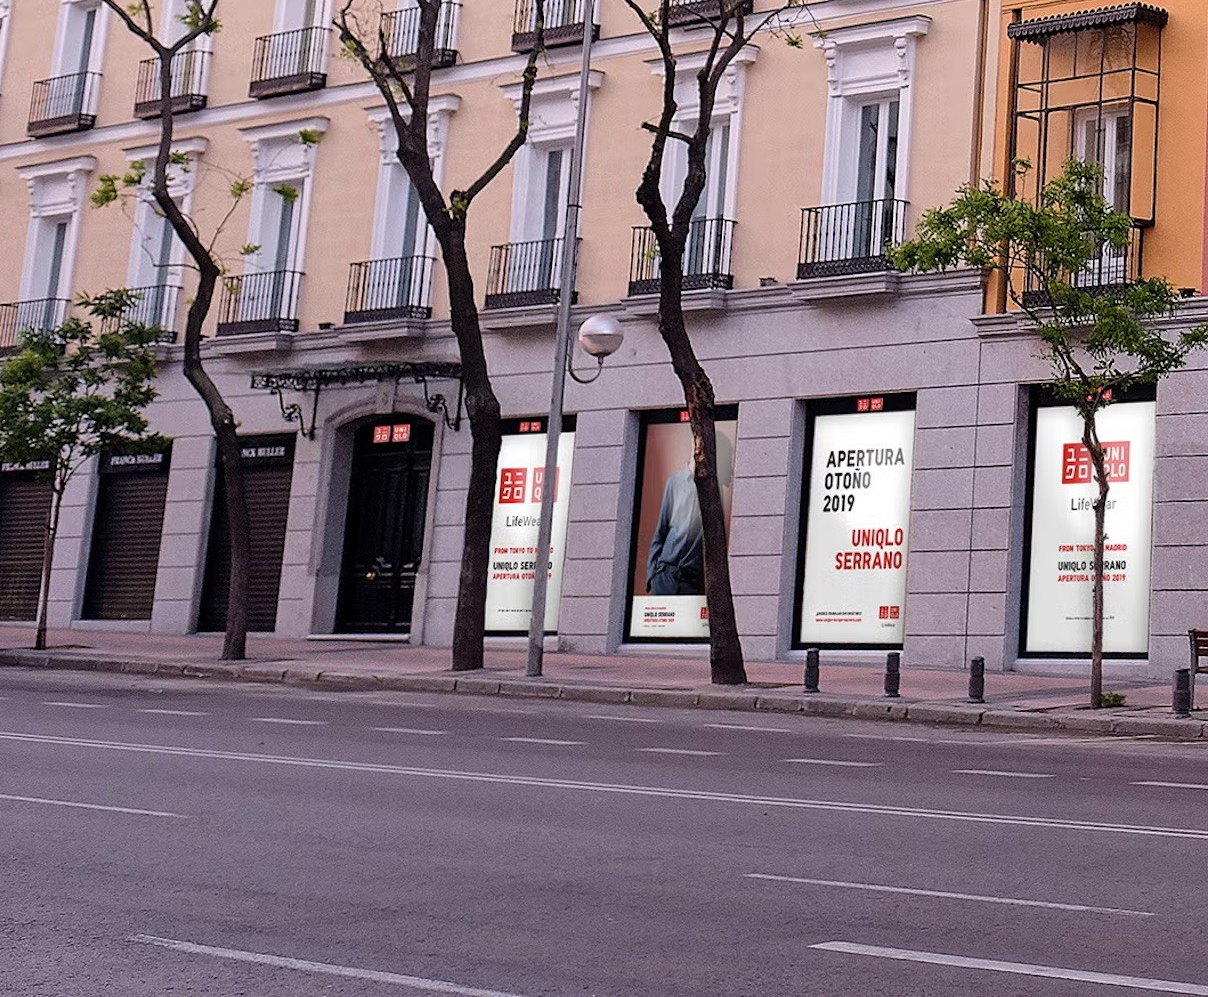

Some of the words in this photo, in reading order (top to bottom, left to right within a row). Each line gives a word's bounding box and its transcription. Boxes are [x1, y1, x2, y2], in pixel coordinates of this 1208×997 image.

[826, 448, 905, 468] APERTURA
[824, 468, 871, 490] OTOÑO
[823, 494, 855, 512] 2019
[506, 516, 541, 527] LifeWea
[852, 528, 904, 549] UNIQLO
[493, 562, 518, 571] UNIQLO
[835, 551, 902, 570] SERRANO
[1058, 561, 1086, 572] UNIQLO
[1058, 574, 1089, 582] APERTURA
